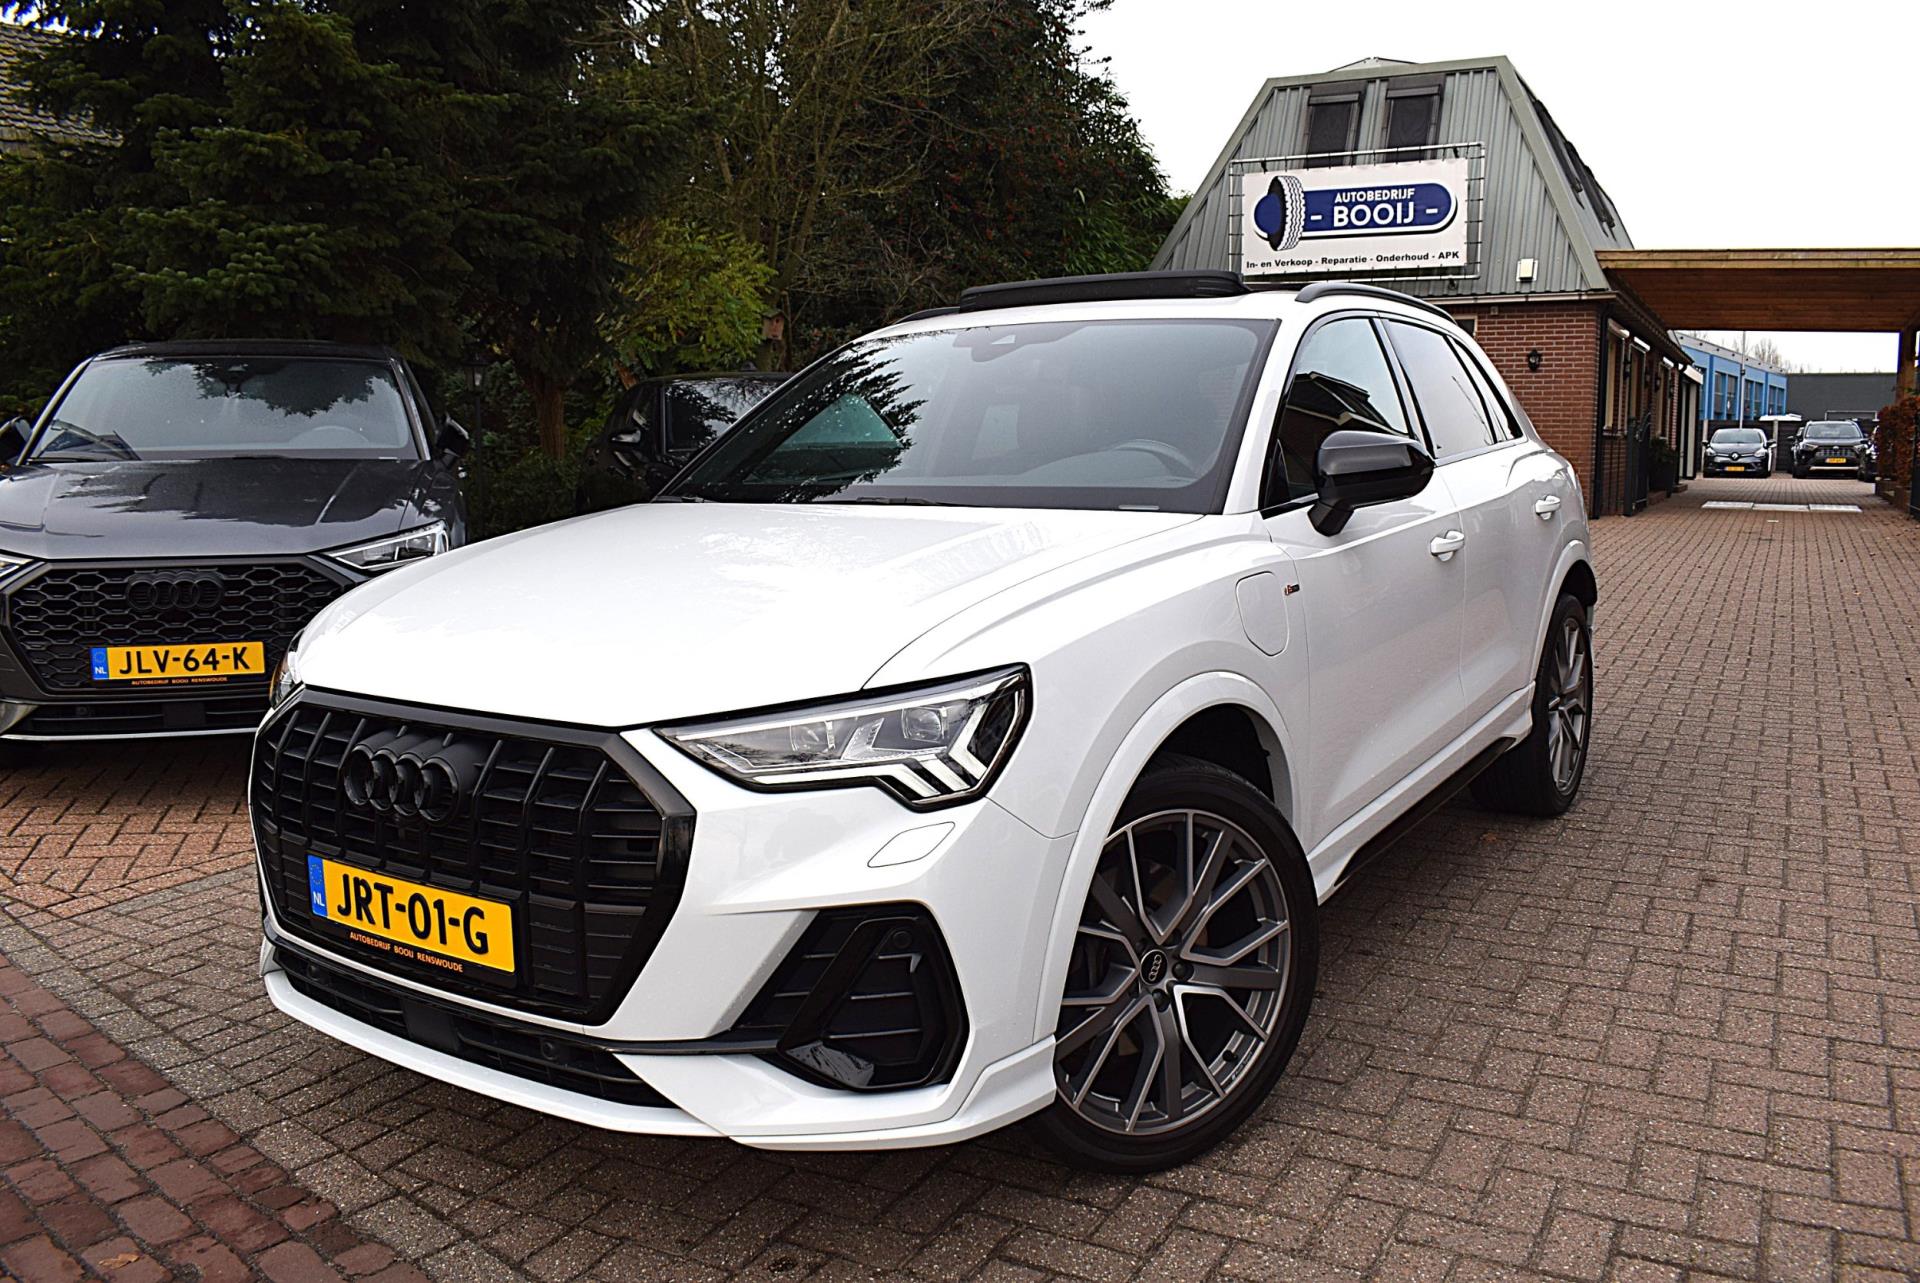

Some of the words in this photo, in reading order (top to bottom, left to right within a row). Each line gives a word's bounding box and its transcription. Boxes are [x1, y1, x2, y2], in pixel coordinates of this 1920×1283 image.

[1334, 188, 1415, 203] AUTOBEDRIJF
[1333, 202, 1414, 227] BOOIJ
[1274, 258, 1313, 267] Verkoop
[1321, 256, 1367, 265] Reparatie
[1376, 252, 1429, 262] Onderhoud
[1438, 251, 1459, 259] APK
[94, 667, 107, 675] NL
[119, 646, 250, 674] JLV-64-K
[313, 891, 325, 907] NL
[337, 873, 489, 955] JRT-01-G
[349, 931, 391, 951] AUTOBEDRIJF
[393, 945, 414, 958] BOOIJ
[416, 952, 464, 973] RENSWOUDE
